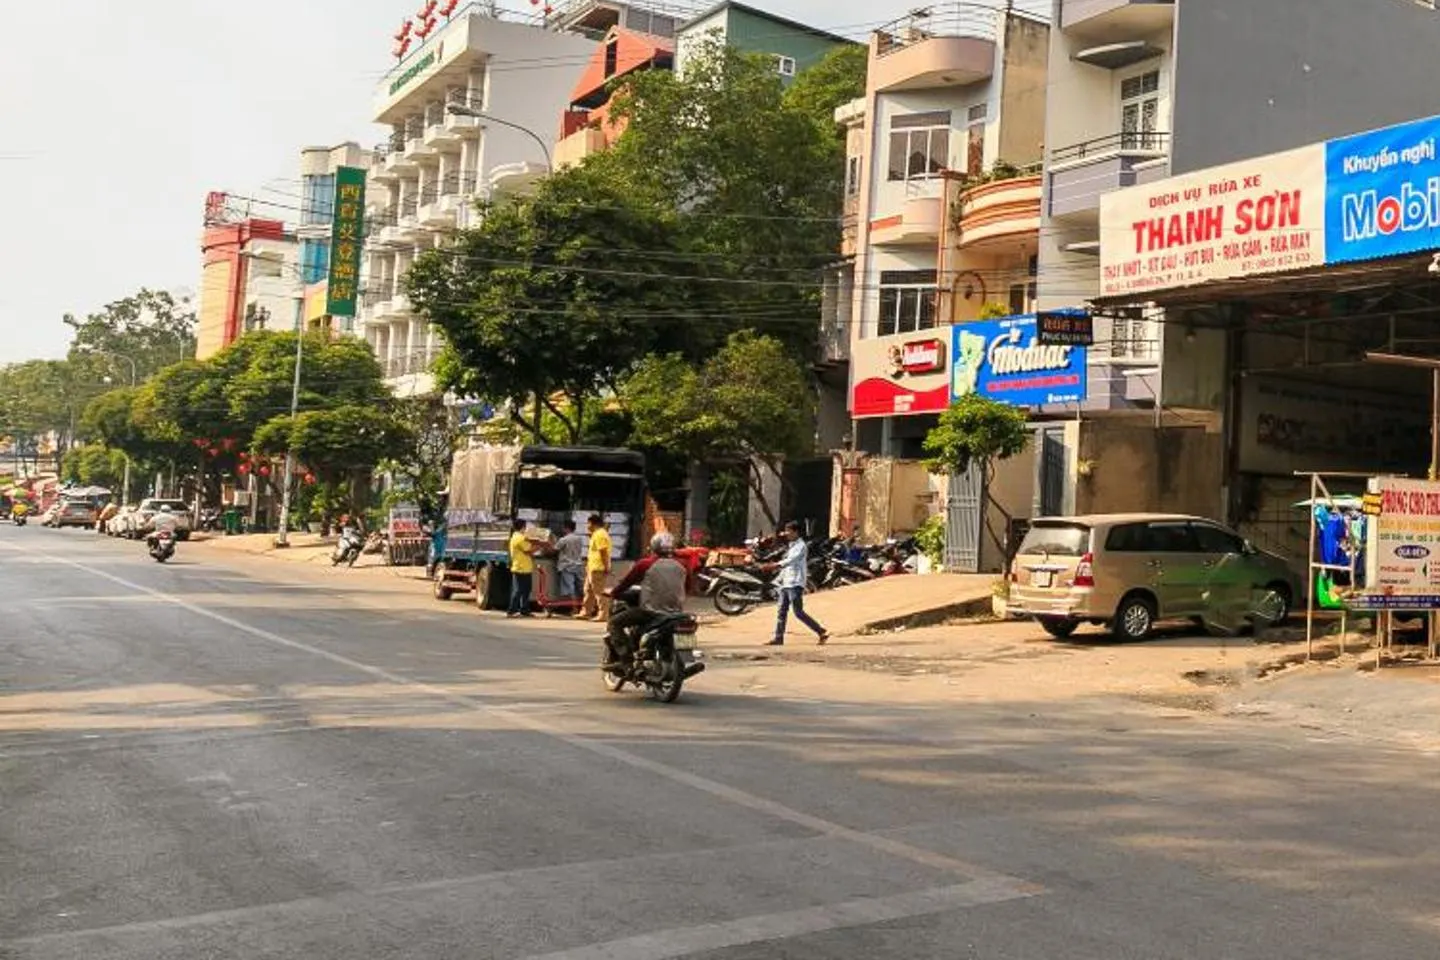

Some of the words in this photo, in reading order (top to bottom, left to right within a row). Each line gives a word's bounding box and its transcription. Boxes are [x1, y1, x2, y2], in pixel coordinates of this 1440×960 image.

[1343, 146, 1398, 174] Khuyến
[1401, 138, 1436, 165] nghị
[1243, 174, 1262, 189] XE
[1132, 205, 1224, 254] THANH
[1234, 189, 1302, 235] SƠN
